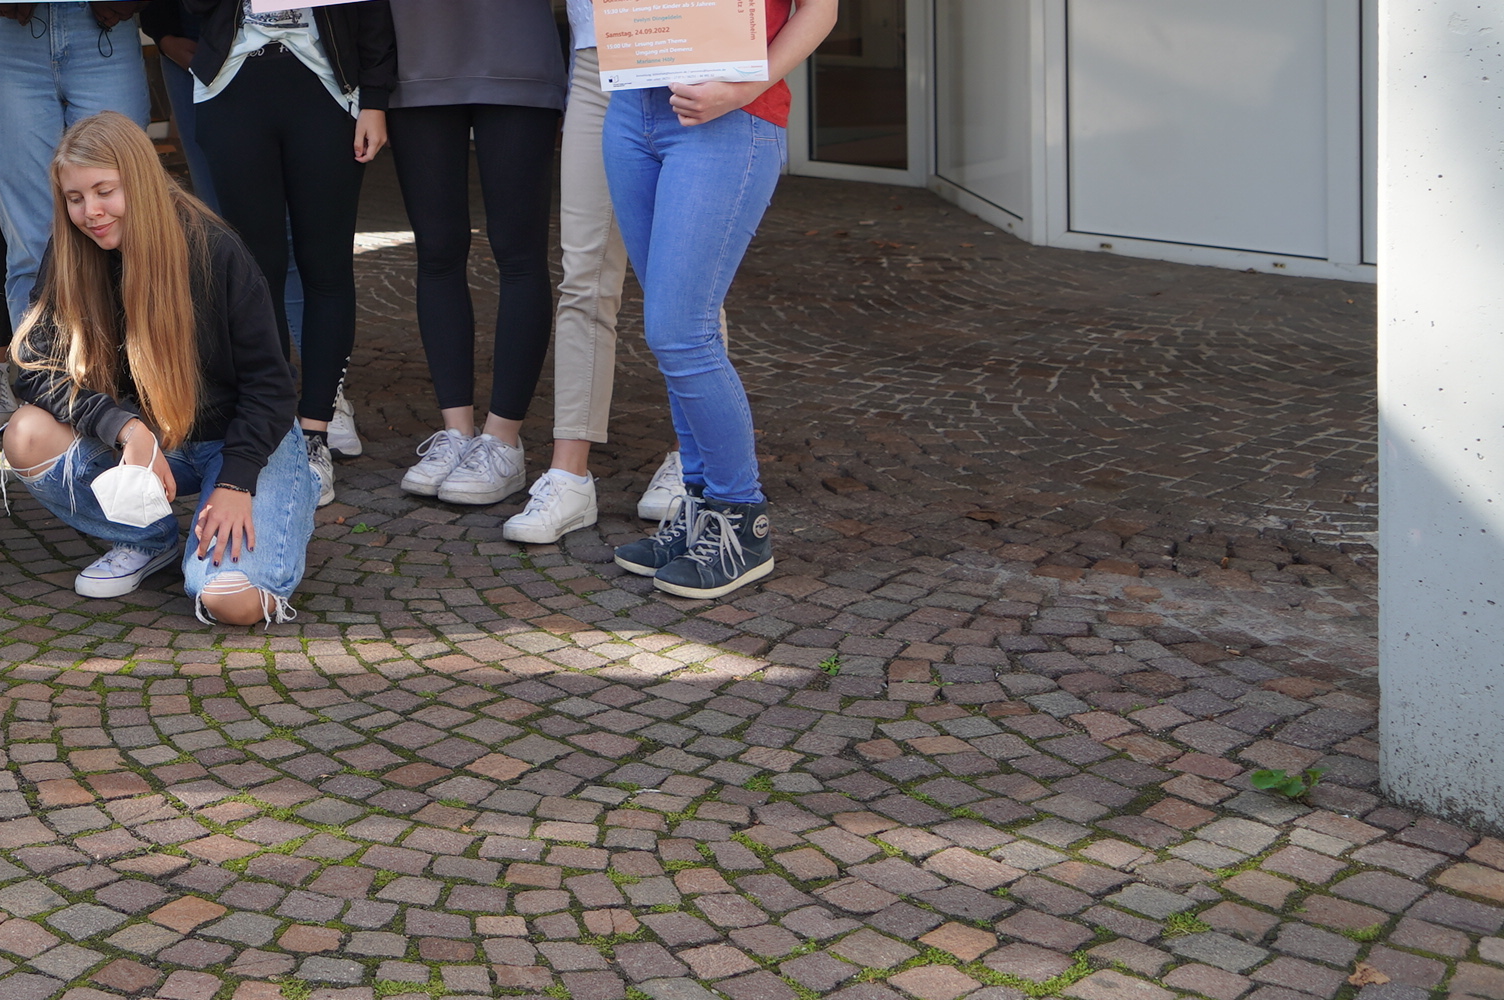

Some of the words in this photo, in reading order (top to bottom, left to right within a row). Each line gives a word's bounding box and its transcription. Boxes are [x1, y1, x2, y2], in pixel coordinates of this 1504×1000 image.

[749, 8, 757, 40] Bensheim
[635, 27, 670, 36] 24.09.2022
[636, 48, 658, 56] Umgang
